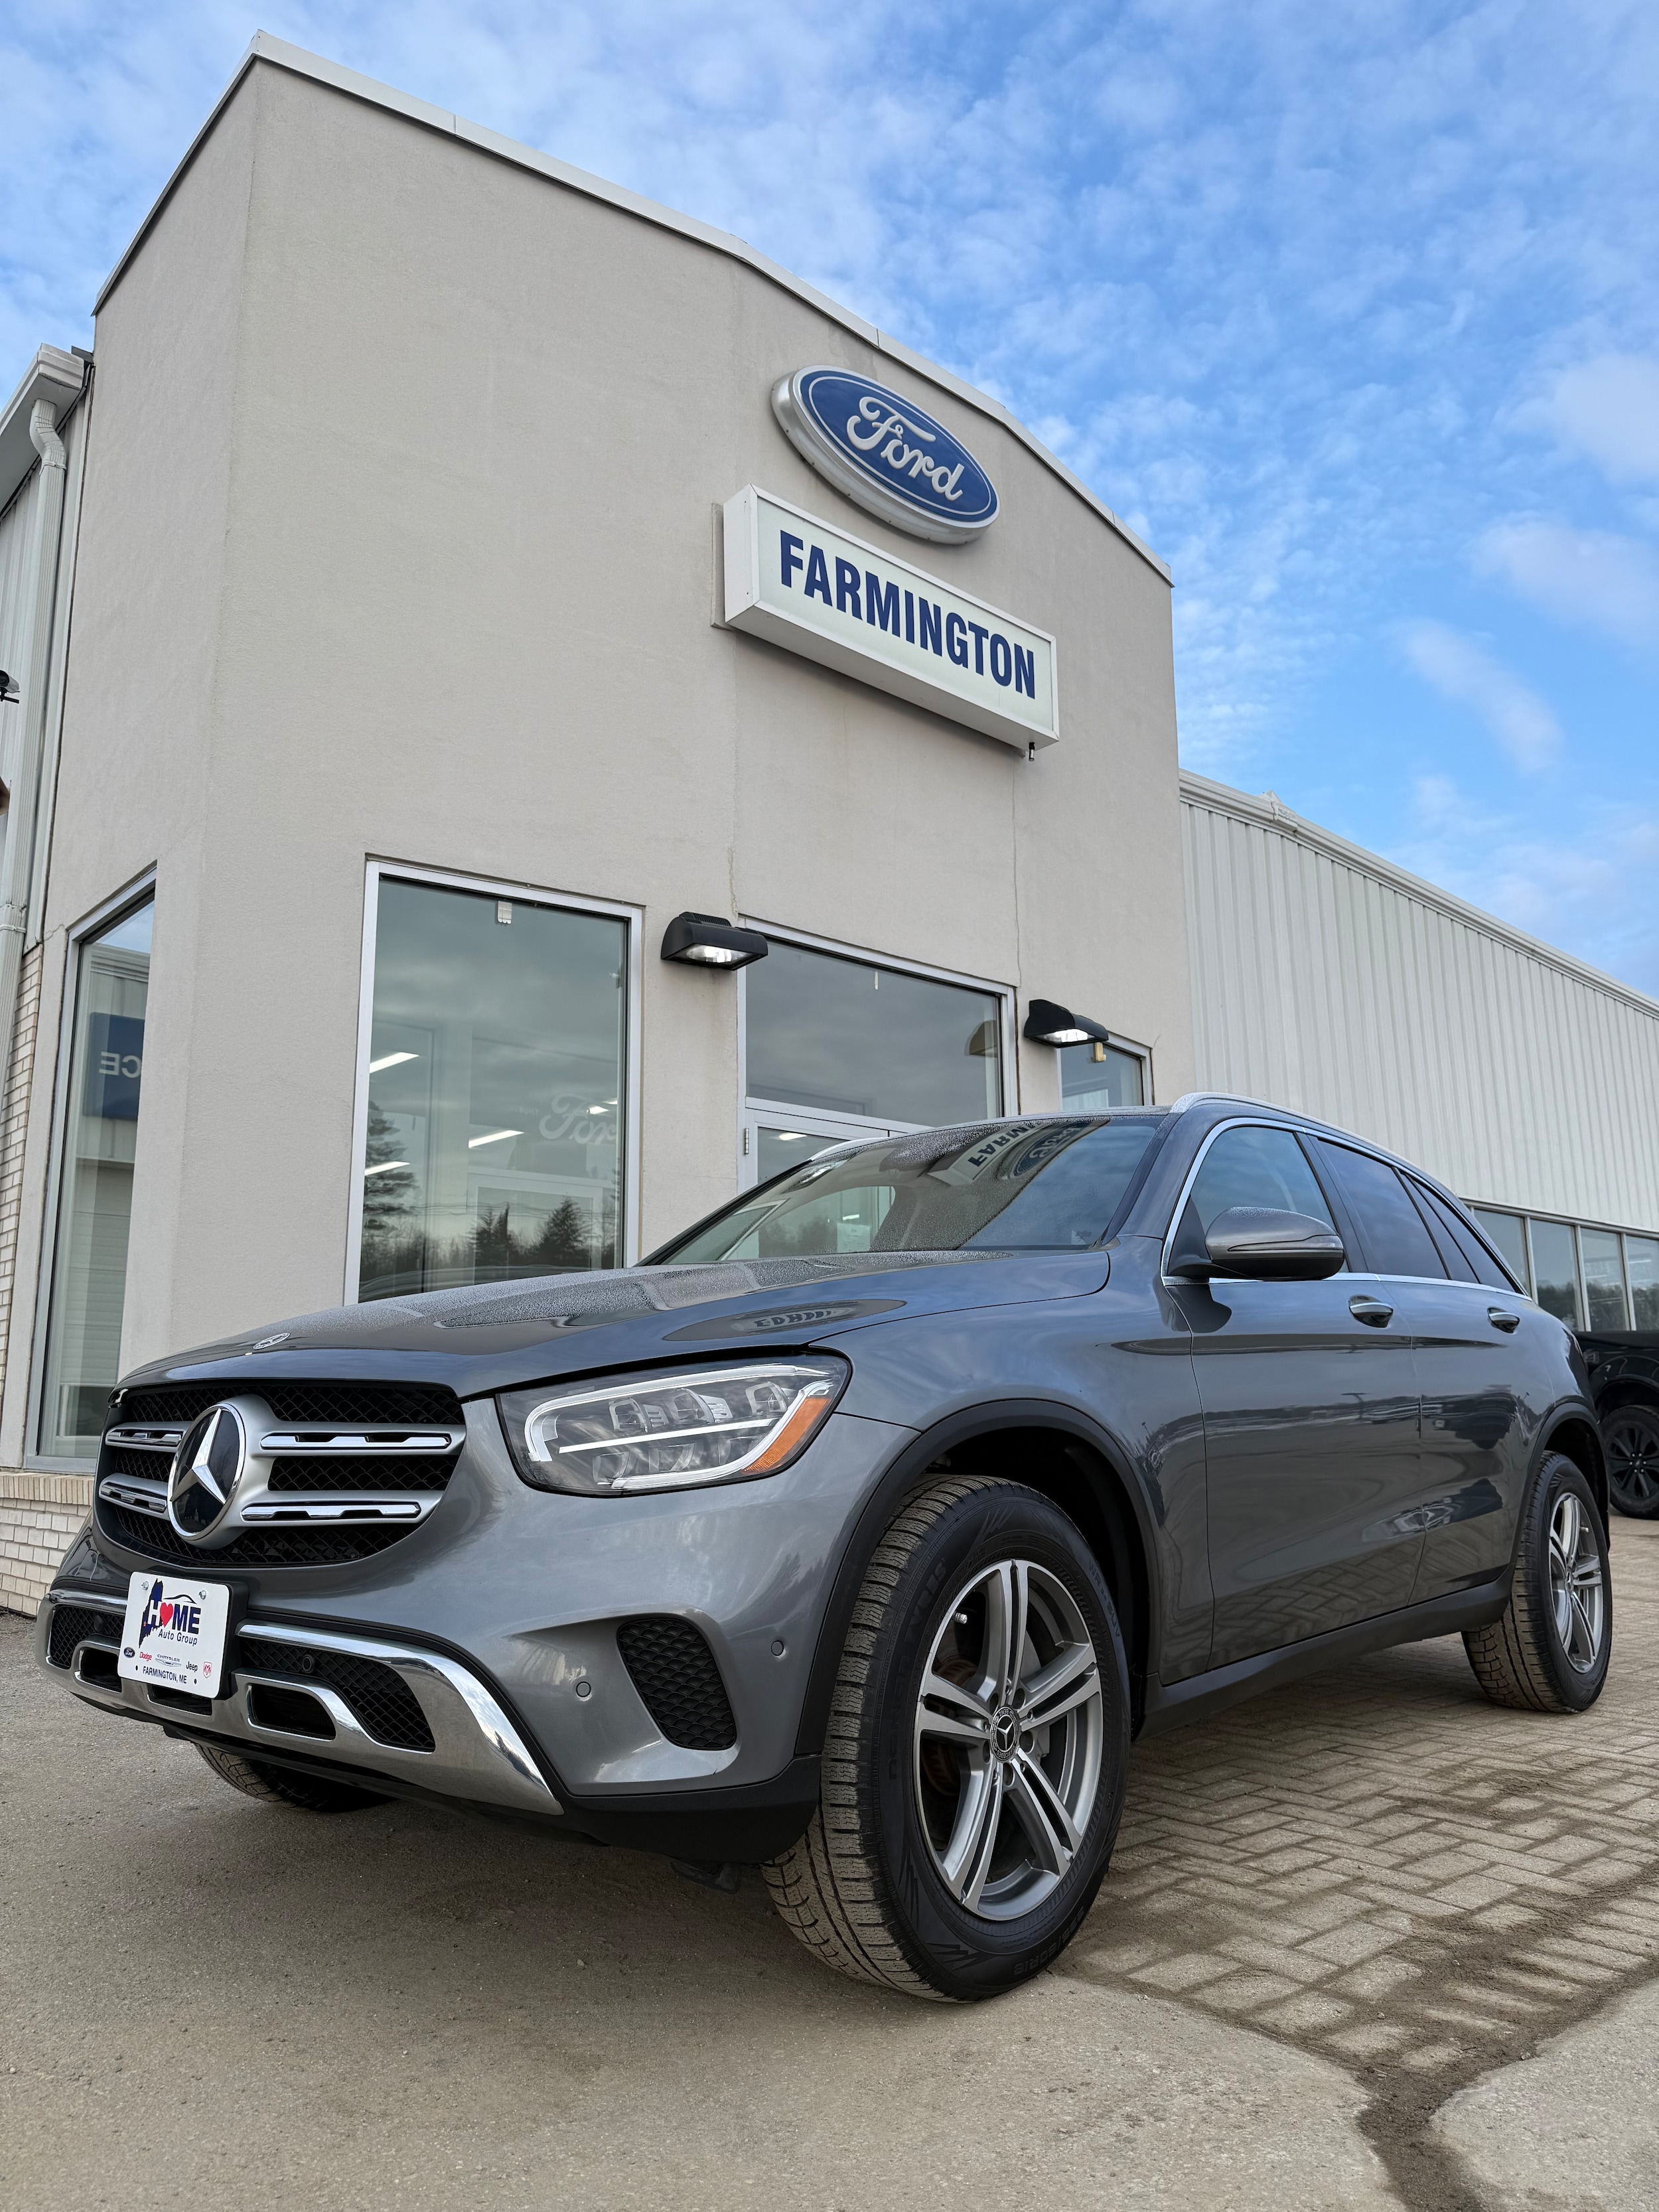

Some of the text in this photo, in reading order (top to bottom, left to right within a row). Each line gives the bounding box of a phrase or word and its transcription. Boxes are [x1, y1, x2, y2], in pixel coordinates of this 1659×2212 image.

[847, 396, 964, 501] Ford
[780, 530, 1035, 700] FARMINGTON
[158, 1629, 198, 1647] Auto Group
[139, 1651, 153, 1662] Dodge
[157, 1654, 180, 1662] CHRYSLER
[186, 1661, 198, 1672] Jeep
[143, 1666, 187, 1684] FARMINGTON, ME
